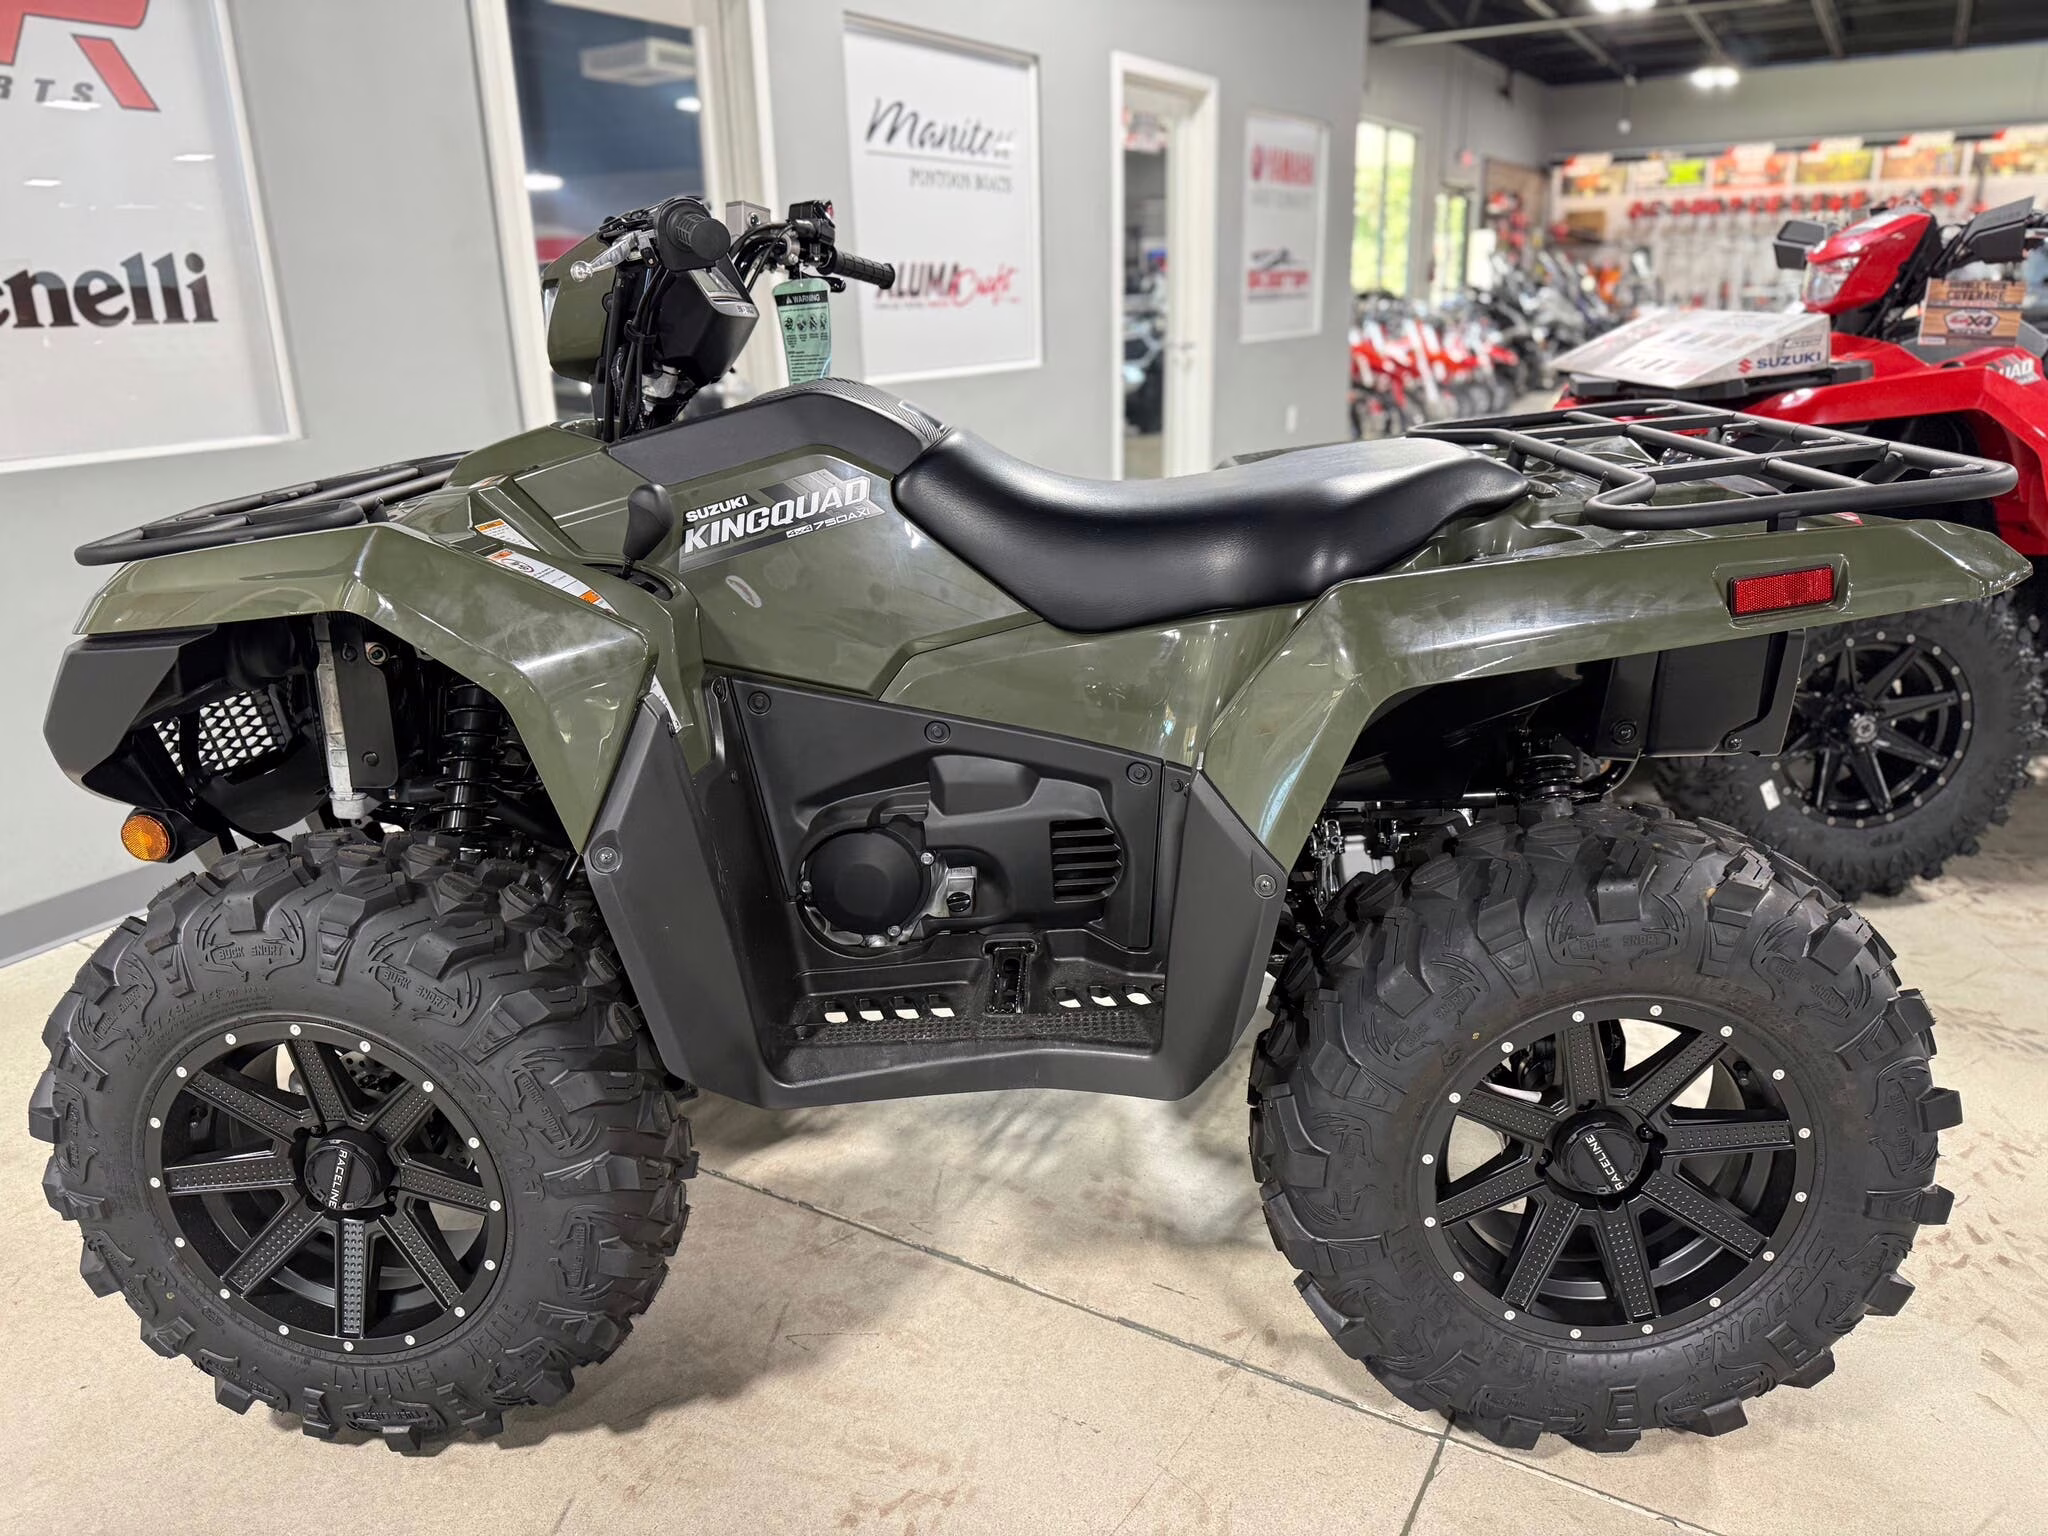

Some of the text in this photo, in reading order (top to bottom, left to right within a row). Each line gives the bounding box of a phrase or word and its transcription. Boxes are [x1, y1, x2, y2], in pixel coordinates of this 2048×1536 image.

[0, 251, 219, 328] nelli
[792, 293, 820, 304] WARNING
[1756, 351, 1822, 370] SUZUKI
[684, 476, 872, 554] KINGQUAD
[685, 495, 749, 523] SUZUKI
[218, 944, 283, 961] BUCK SNORT
[383, 970, 450, 1010] BUCK SNORT
[520, 1075, 566, 1145] BUCK SNORT
[328, 1149, 348, 1209] RACELINE
[1584, 1133, 1625, 1191] RACELINE
